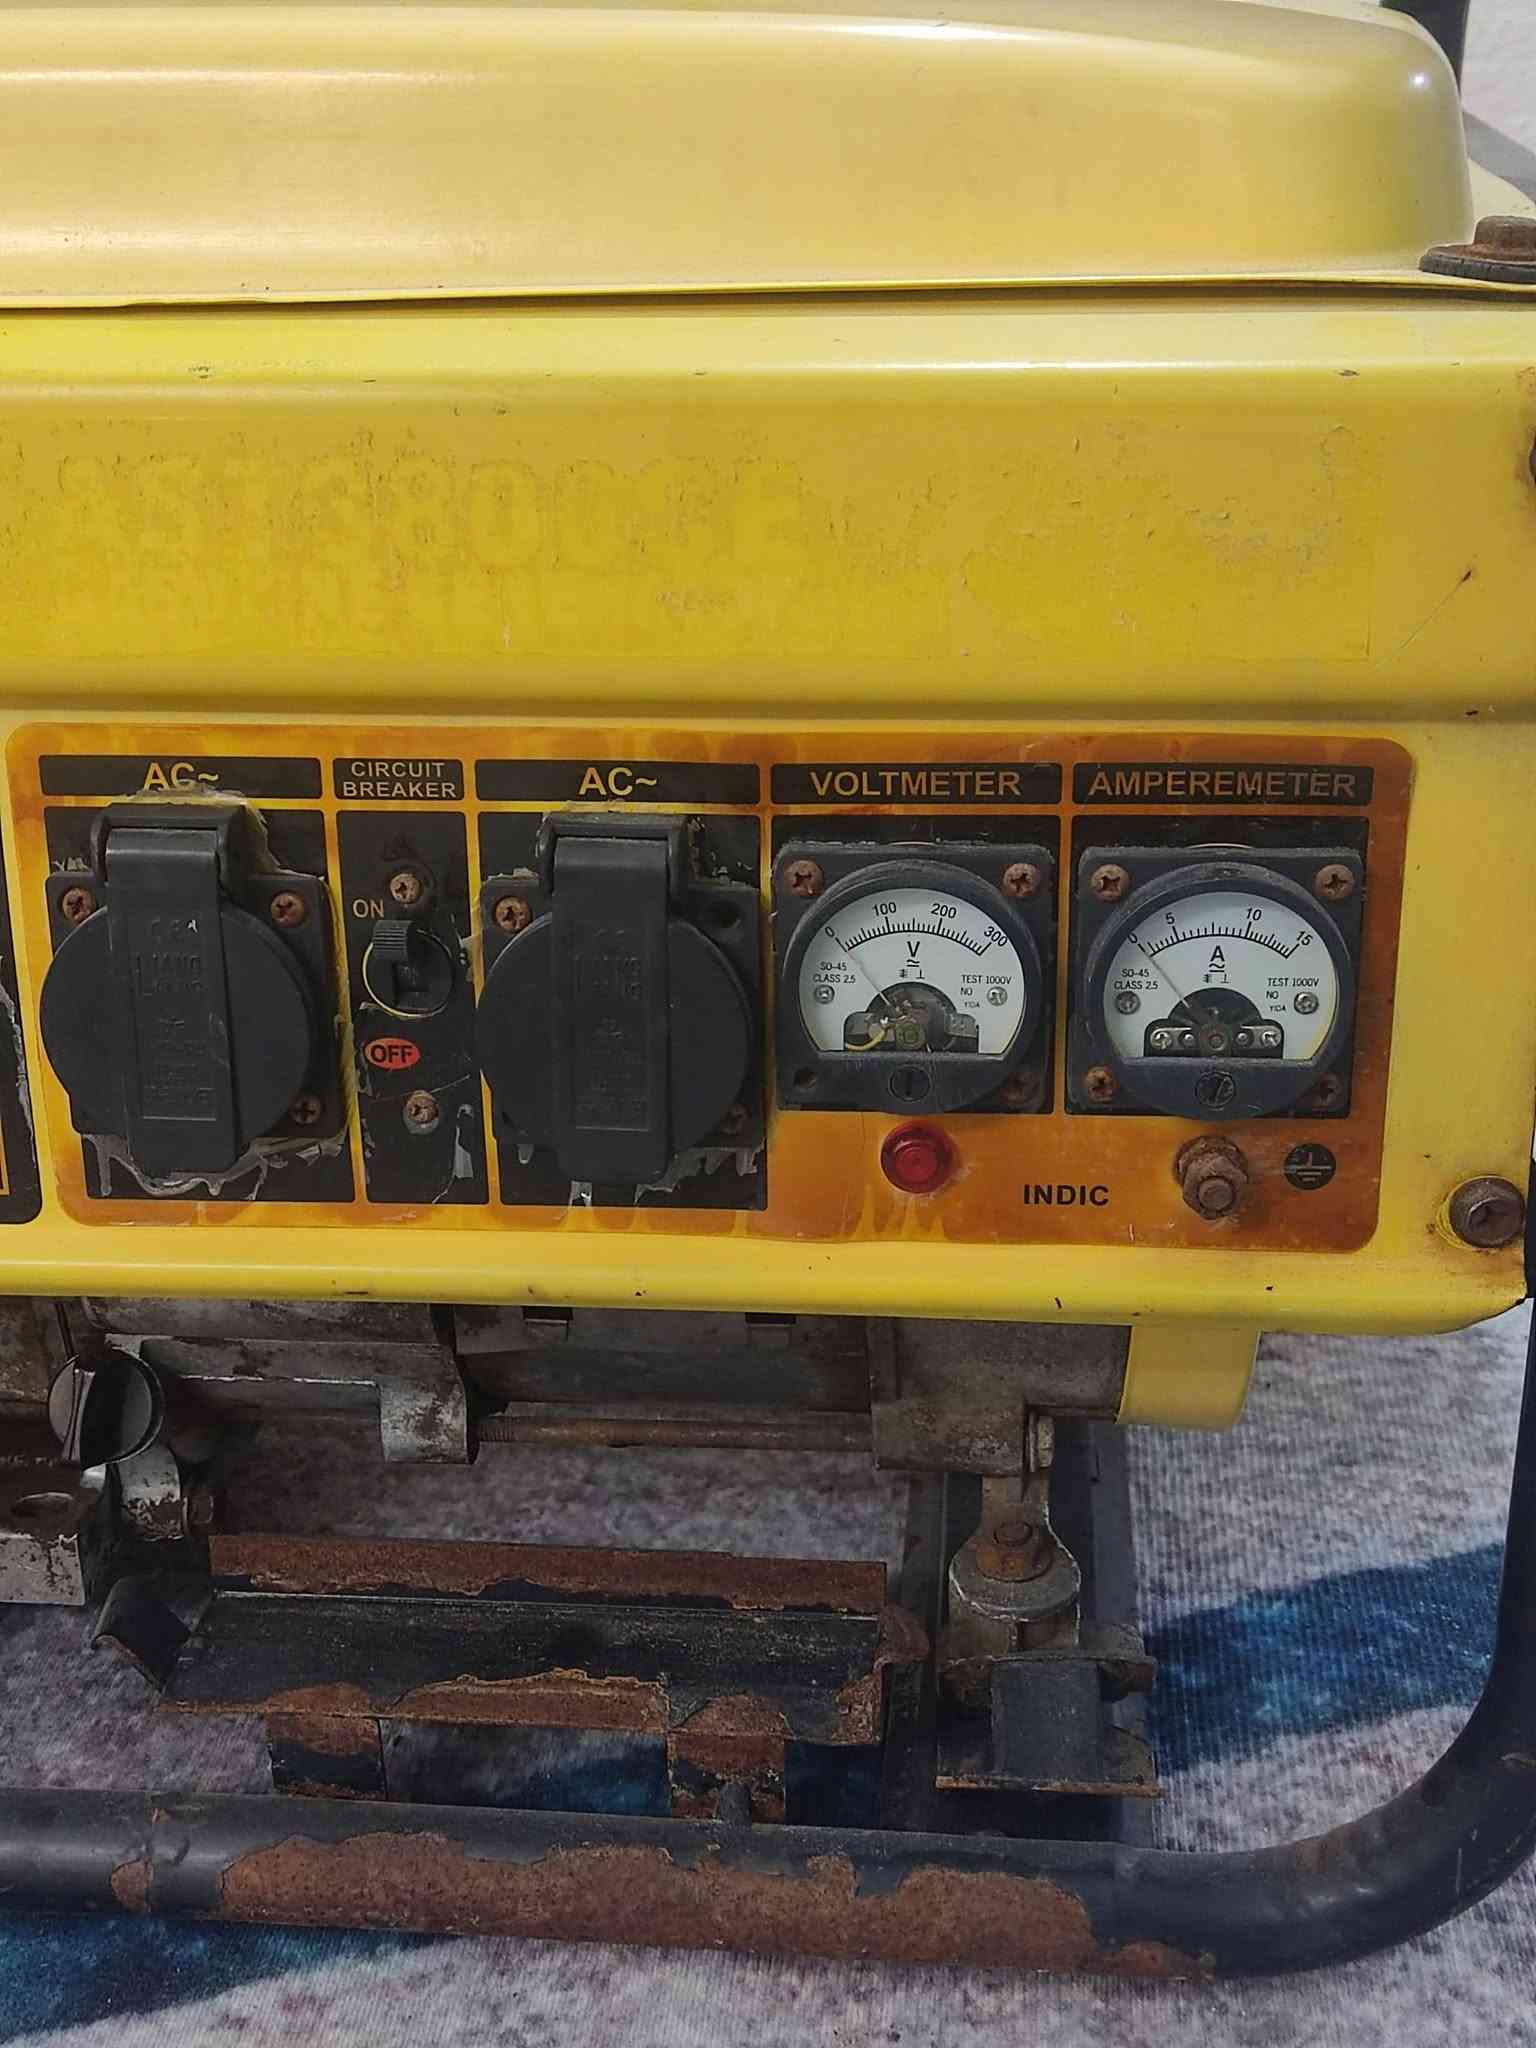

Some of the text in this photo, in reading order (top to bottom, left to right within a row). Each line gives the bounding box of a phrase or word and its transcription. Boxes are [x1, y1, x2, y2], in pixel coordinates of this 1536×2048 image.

[351, 762, 445, 777] CIRCUIT
[343, 782, 457, 798] BREAKER
[810, 771, 1021, 796] VOLTMETER
[1088, 770, 1356, 797] AMPEREMETER
[353, 899, 385, 918] ON
[872, 902, 898, 917] 100
[930, 903, 958, 919] 200
[1245, 907, 1263, 921] 10
[1166, 912, 1176, 925] 5
[825, 926, 836, 939] 0
[983, 926, 1009, 947] 300
[1295, 929, 1315, 946] 15
[906, 941, 921, 958] V
[1209, 945, 1226, 962] A
[812, 973, 841, 983] CLASS
[961, 974, 1013, 985] TEST 1000V
[1114, 980, 1143, 990] CLASS
[1268, 977, 1320, 987] TEST 1000V
[370, 1044, 413, 1063] OFF
[1024, 1184, 1109, 1206] INDIC
